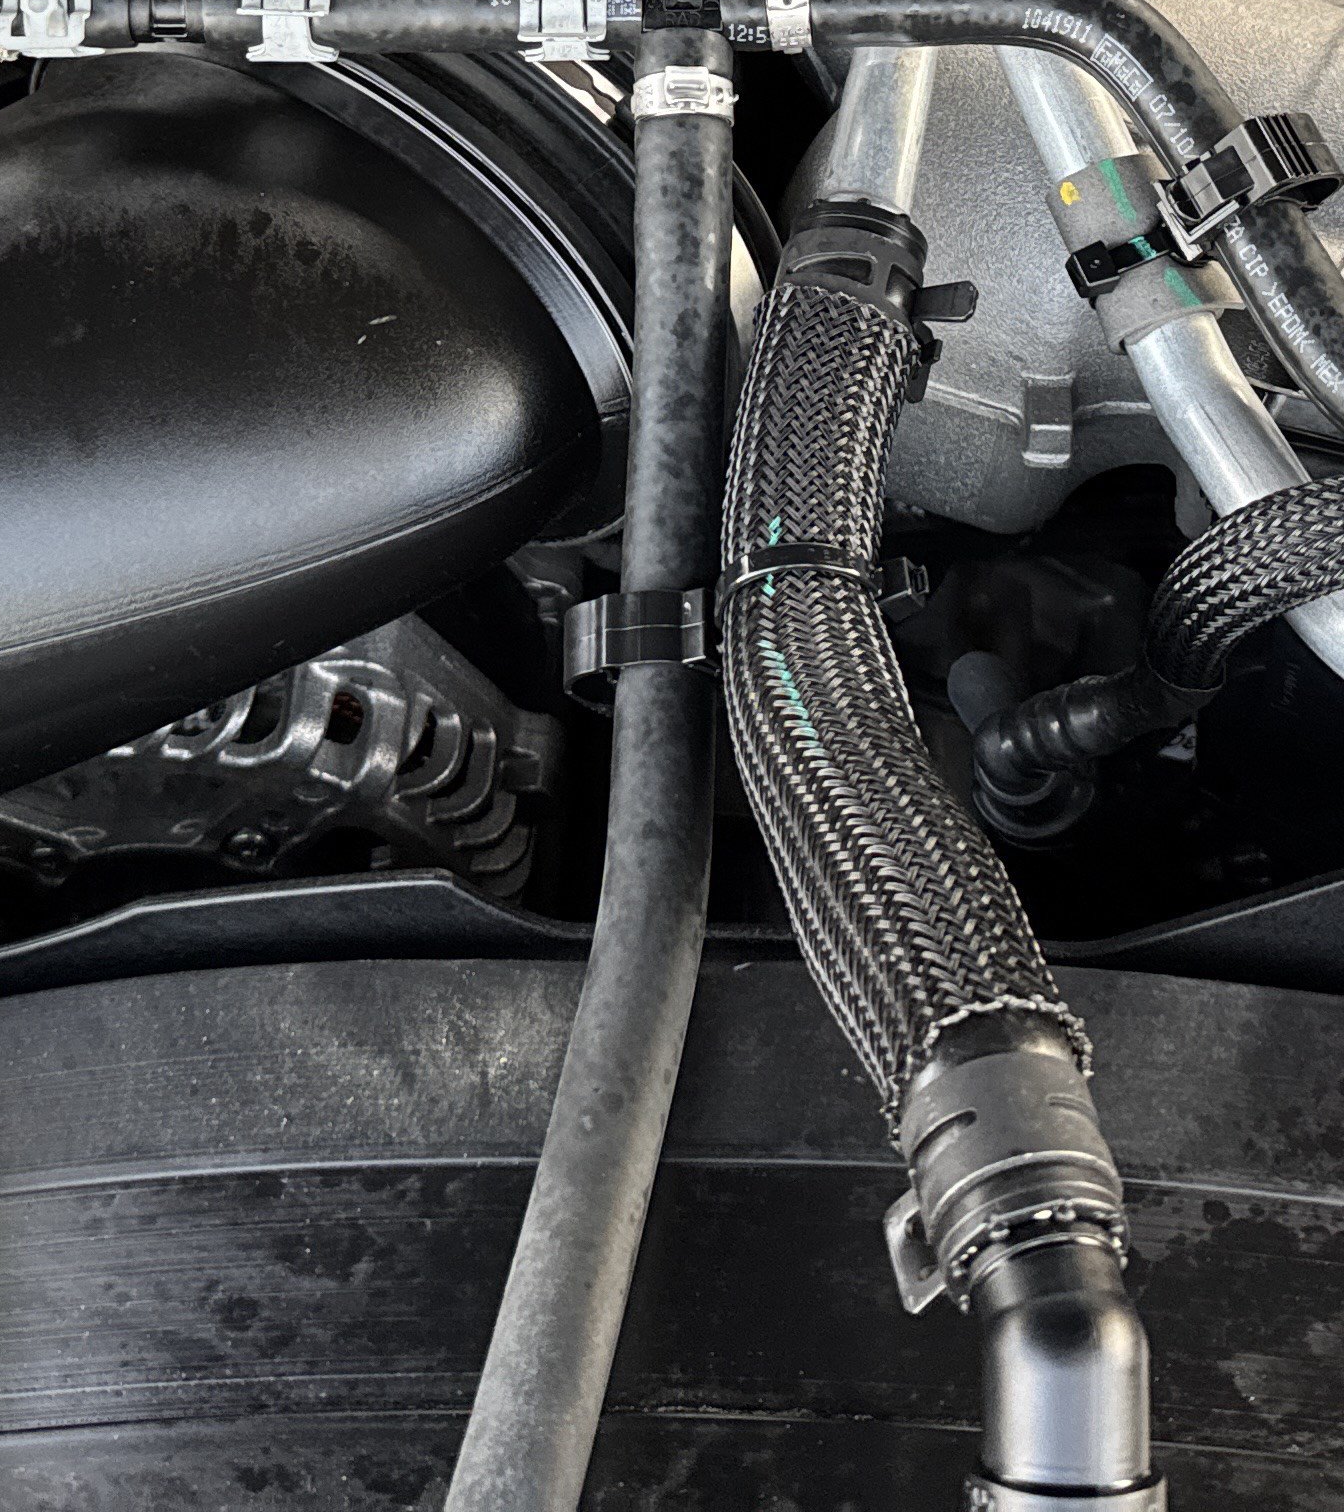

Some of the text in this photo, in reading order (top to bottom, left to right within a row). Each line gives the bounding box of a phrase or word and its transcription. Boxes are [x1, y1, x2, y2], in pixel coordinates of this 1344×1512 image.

[728, 23, 769, 43] 12:5
[1237, 243, 1270, 281] CIP
[1261, 283, 1316, 354] >EPDM<
